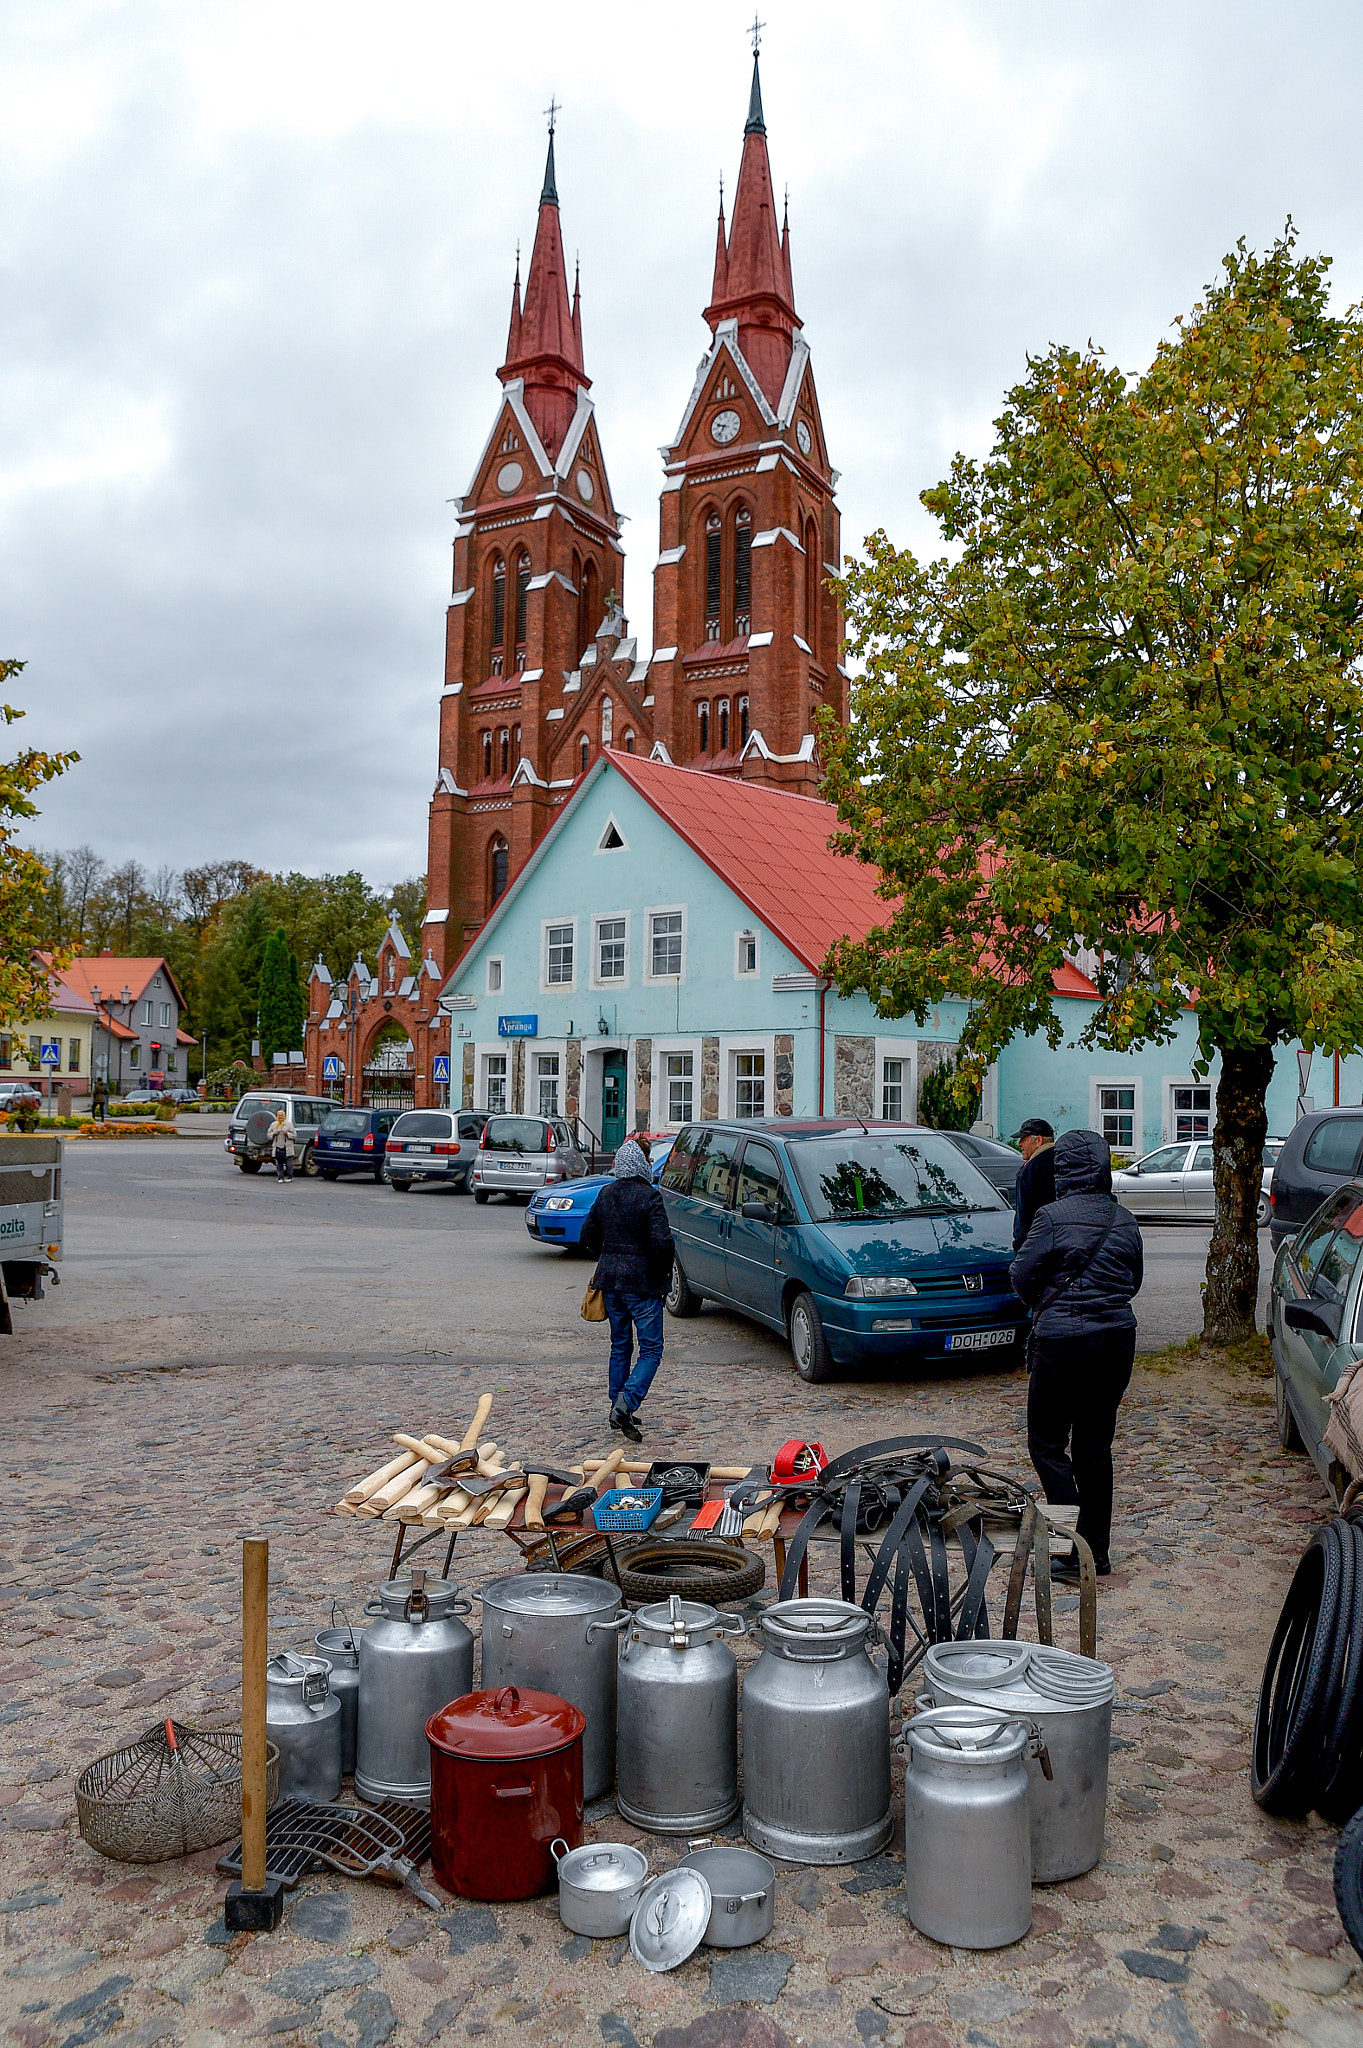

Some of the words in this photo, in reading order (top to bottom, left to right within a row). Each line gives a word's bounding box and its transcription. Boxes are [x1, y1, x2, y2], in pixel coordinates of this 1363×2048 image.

[500, 1018, 532, 1033] Apranga
[953, 1334, 982, 1348] DOH
[990, 1330, 1013, 1344] 026
